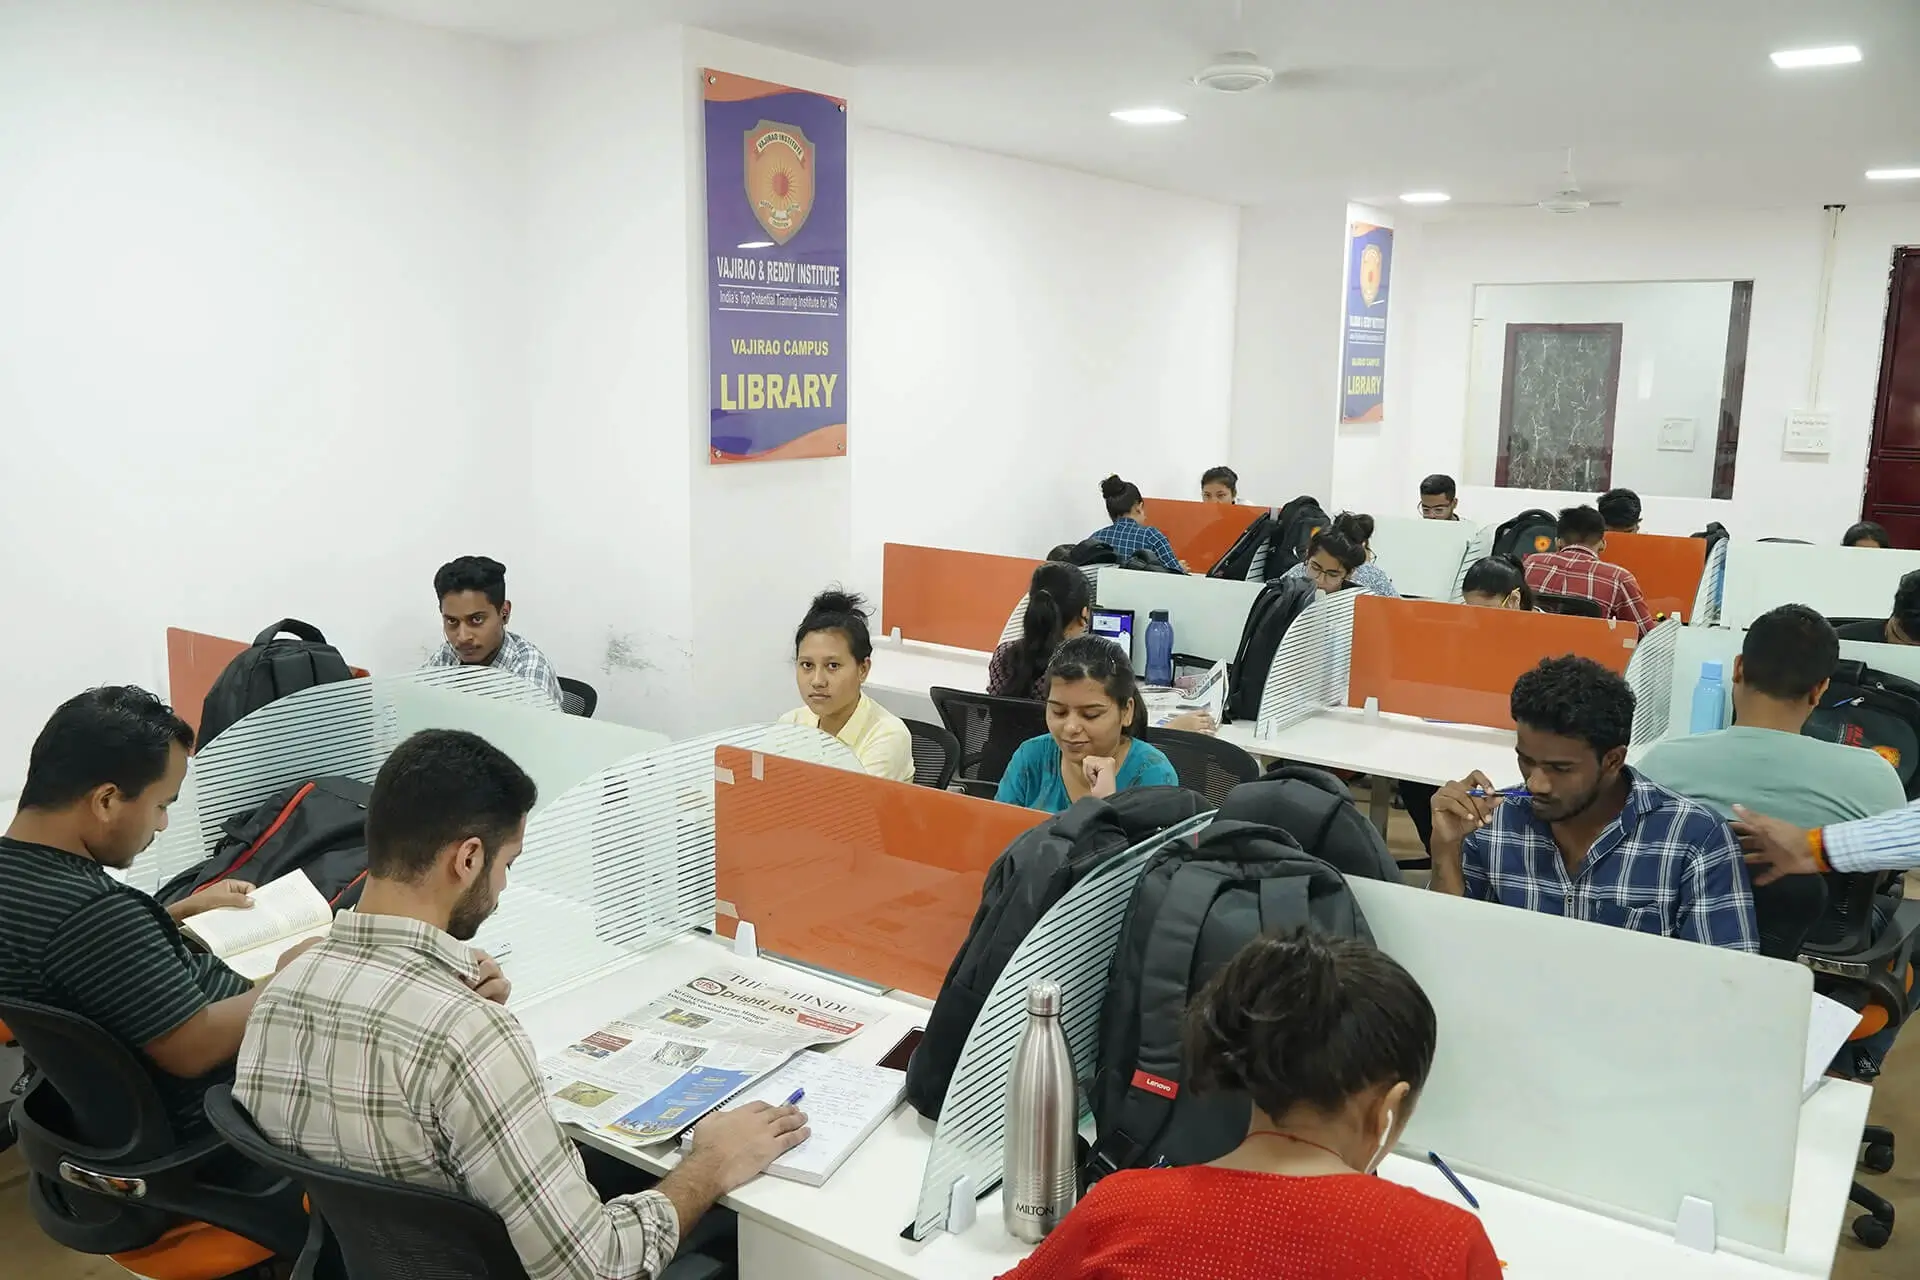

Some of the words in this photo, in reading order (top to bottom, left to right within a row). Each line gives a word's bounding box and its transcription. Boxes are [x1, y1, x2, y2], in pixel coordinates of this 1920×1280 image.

[717, 256, 756, 280] VAJIRAO
[758, 260, 765, 281] &
[766, 261, 796, 284] REDDY
[797, 263, 840, 286] INSTITUTE
[719, 290, 739, 304] India's
[740, 291, 750, 307] Top
[751, 292, 776, 306] Potential
[776, 293, 798, 310] Training
[799, 295, 819, 309] Institute
[820, 296, 828, 309] for
[828, 297, 838, 309] IAS
[731, 339, 781, 355] VAJIRAO
[783, 340, 829, 356] CAMPUS
[720, 374, 839, 410] LIBRARY
[1347, 375, 1382, 396] LIBRARY
[720, 990, 770, 1006] Drishti
[769, 1004, 798, 1015] IAS
[789, 992, 856, 1013] HINDU
[1146, 1078, 1171, 1092] Lenovo
[1015, 1202, 1055, 1217] MILTON
